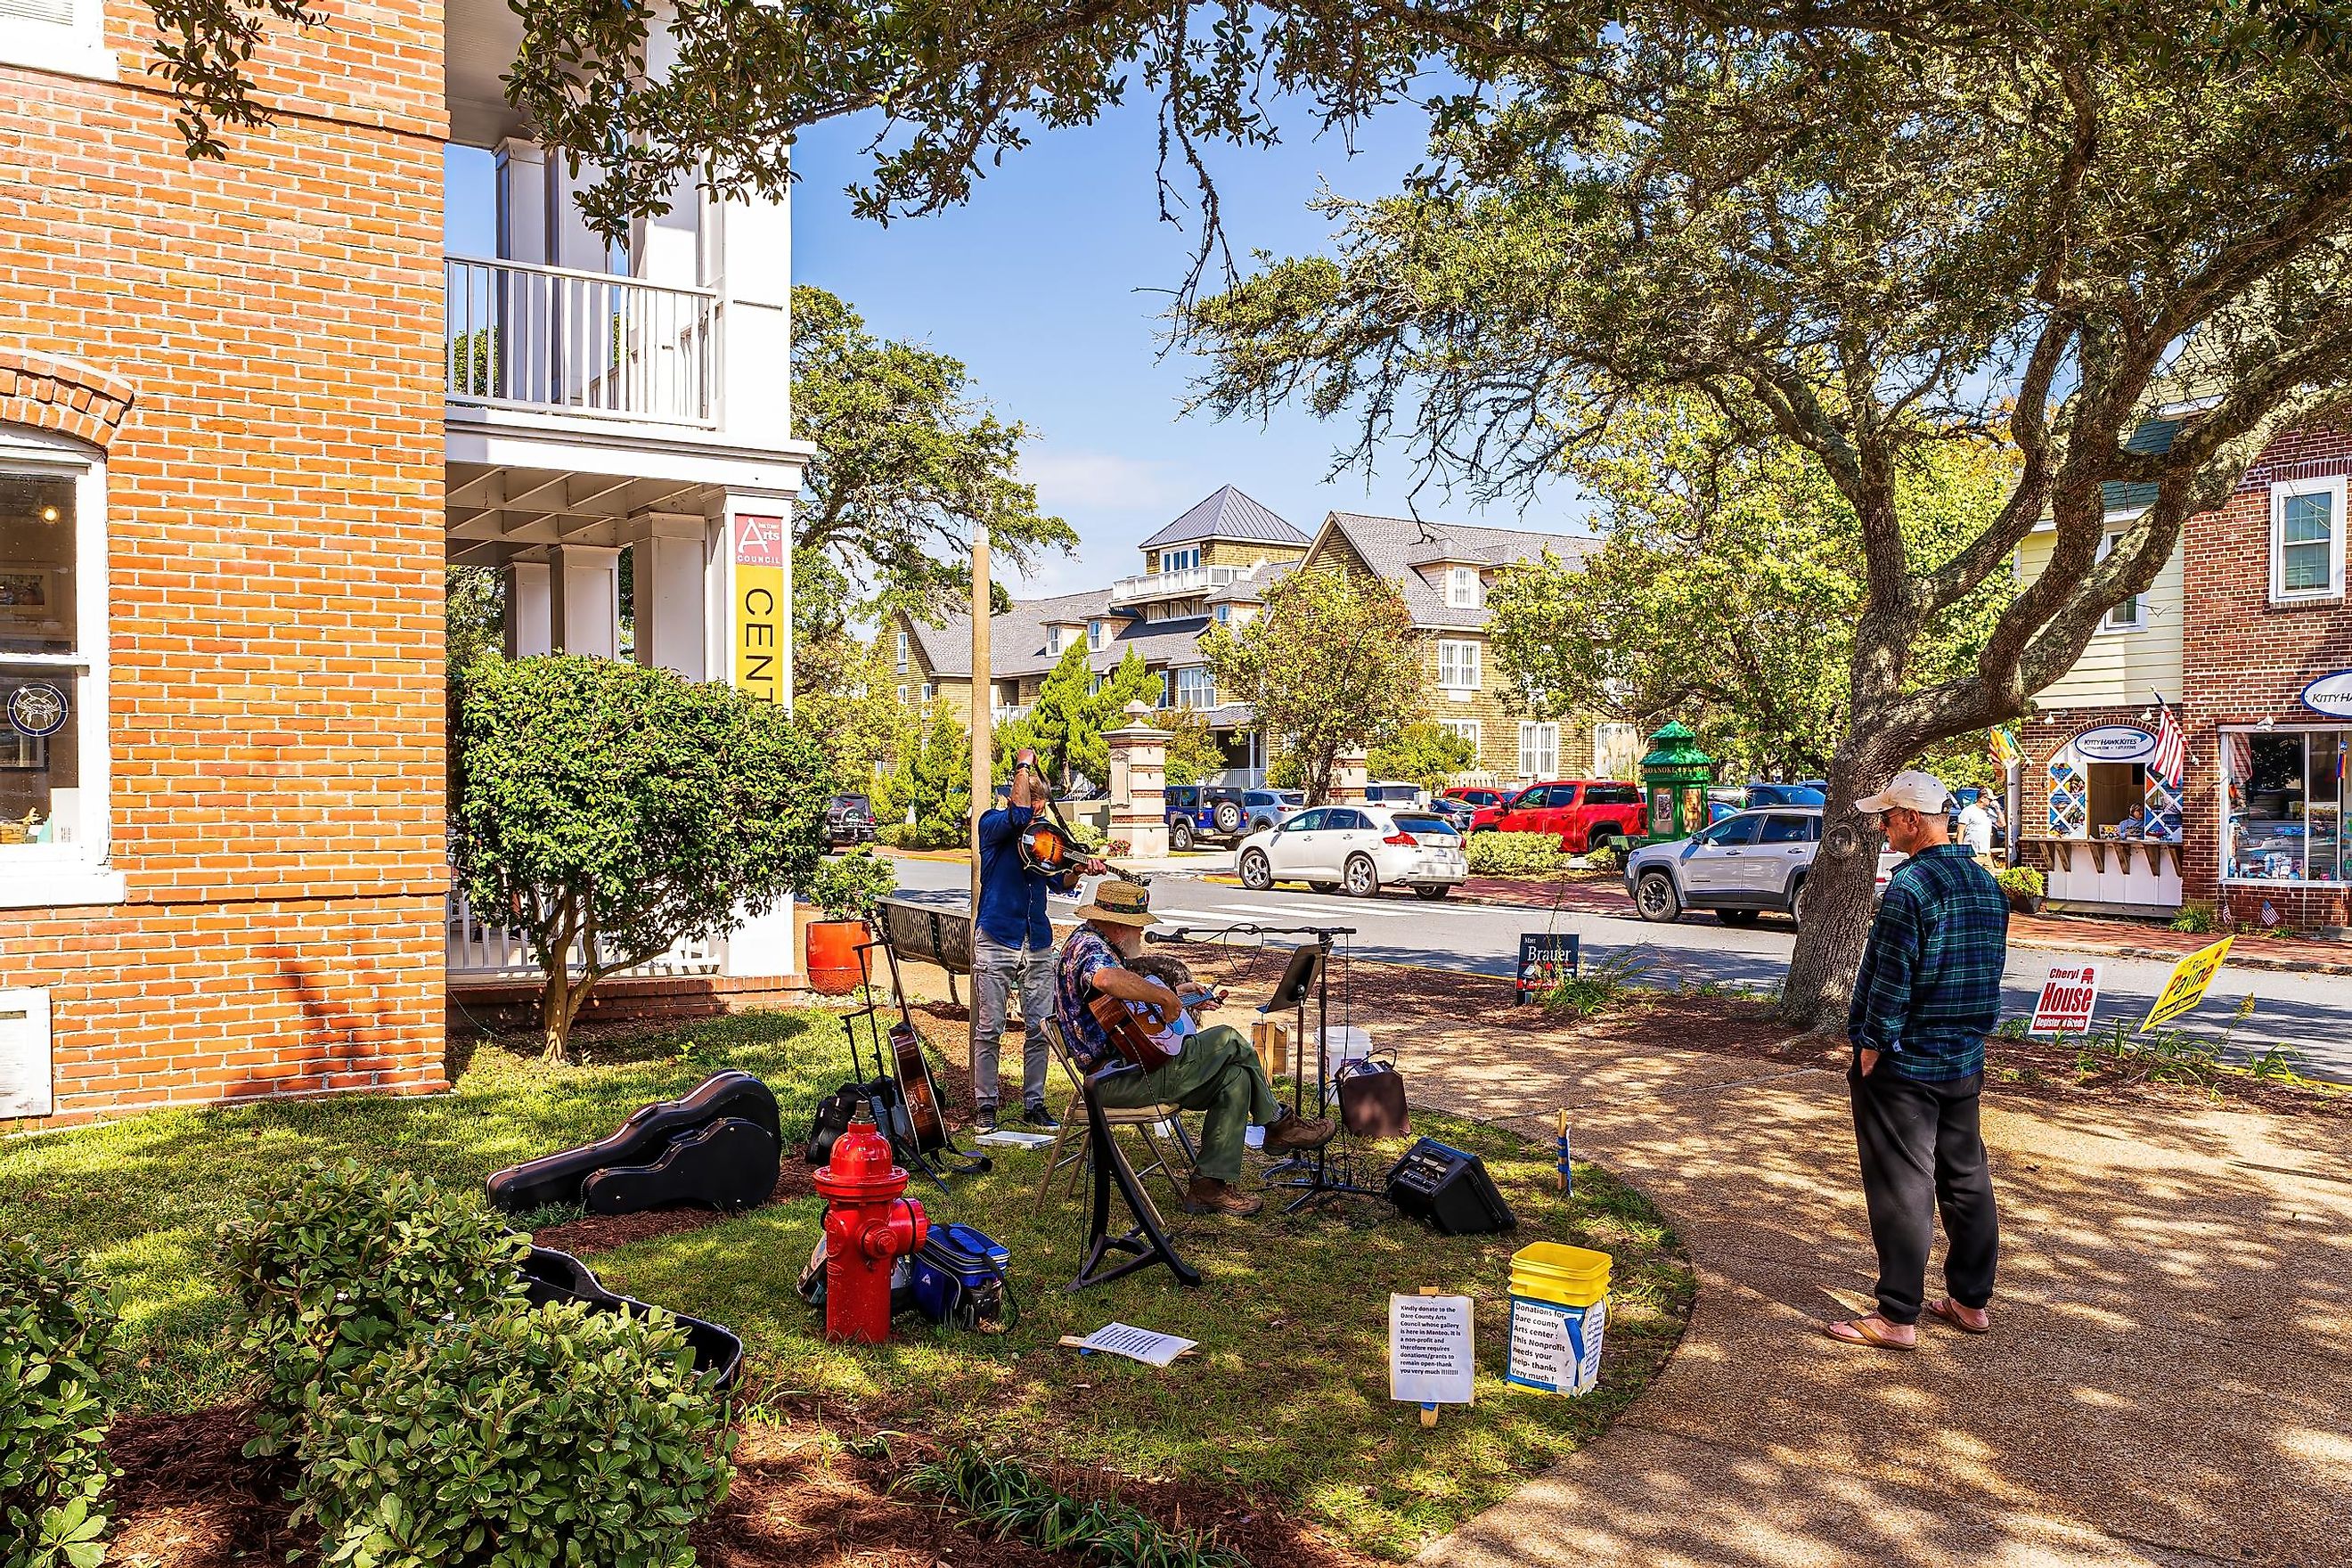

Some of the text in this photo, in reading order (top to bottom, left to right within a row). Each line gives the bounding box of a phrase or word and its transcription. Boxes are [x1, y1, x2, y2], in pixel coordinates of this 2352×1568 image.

[737, 555, 780, 564] COUNCIL
[2312, 694, 2340, 702] KITTY
[1527, 946, 1572, 961] Brauer
[2050, 968, 2080, 980] Cheryl
[2163, 964, 2214, 1002] Payne
[2039, 982, 2093, 1013] House
[2035, 1017, 2061, 1028] Register
[2066, 1018, 2085, 1028] Deeds
[1516, 1303, 1565, 1319] Donations for
[1515, 1314, 1558, 1330] Dare county
[1514, 1325, 1527, 1333] Arts
[1530, 1329, 1554, 1339] center
[1513, 1335, 1565, 1352] This Nonprofit
[1513, 1347, 1533, 1356] needs
[1532, 1362, 1557, 1372] thanks
[1511, 1367, 1527, 1377] Very
[1528, 1373, 1549, 1382] much
